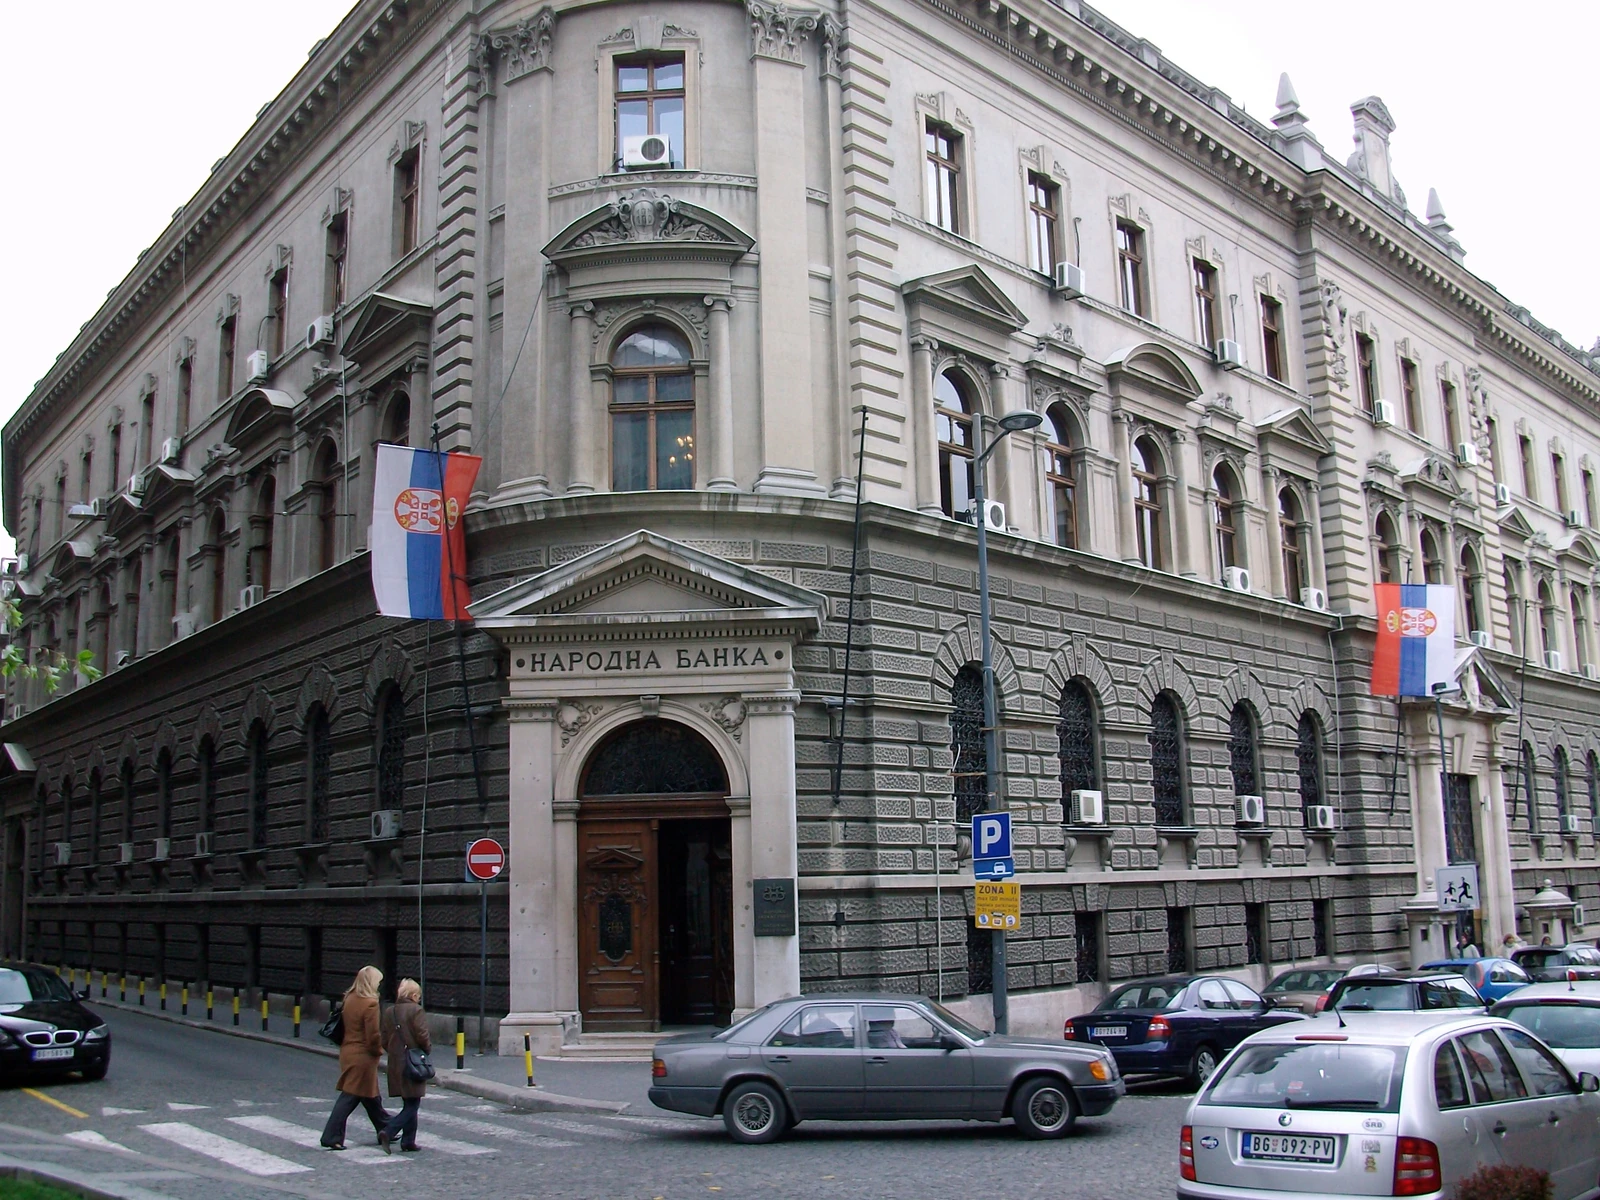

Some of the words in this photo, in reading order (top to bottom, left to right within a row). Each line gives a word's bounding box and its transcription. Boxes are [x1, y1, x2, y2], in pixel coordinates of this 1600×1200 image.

[530, 650, 661, 672] НАРОДНА
[676, 646, 769, 668] БАНКА
[980, 819, 1002, 854] P
[978, 885, 1005, 895] ZONA
[1253, 1136, 1270, 1152] BG
